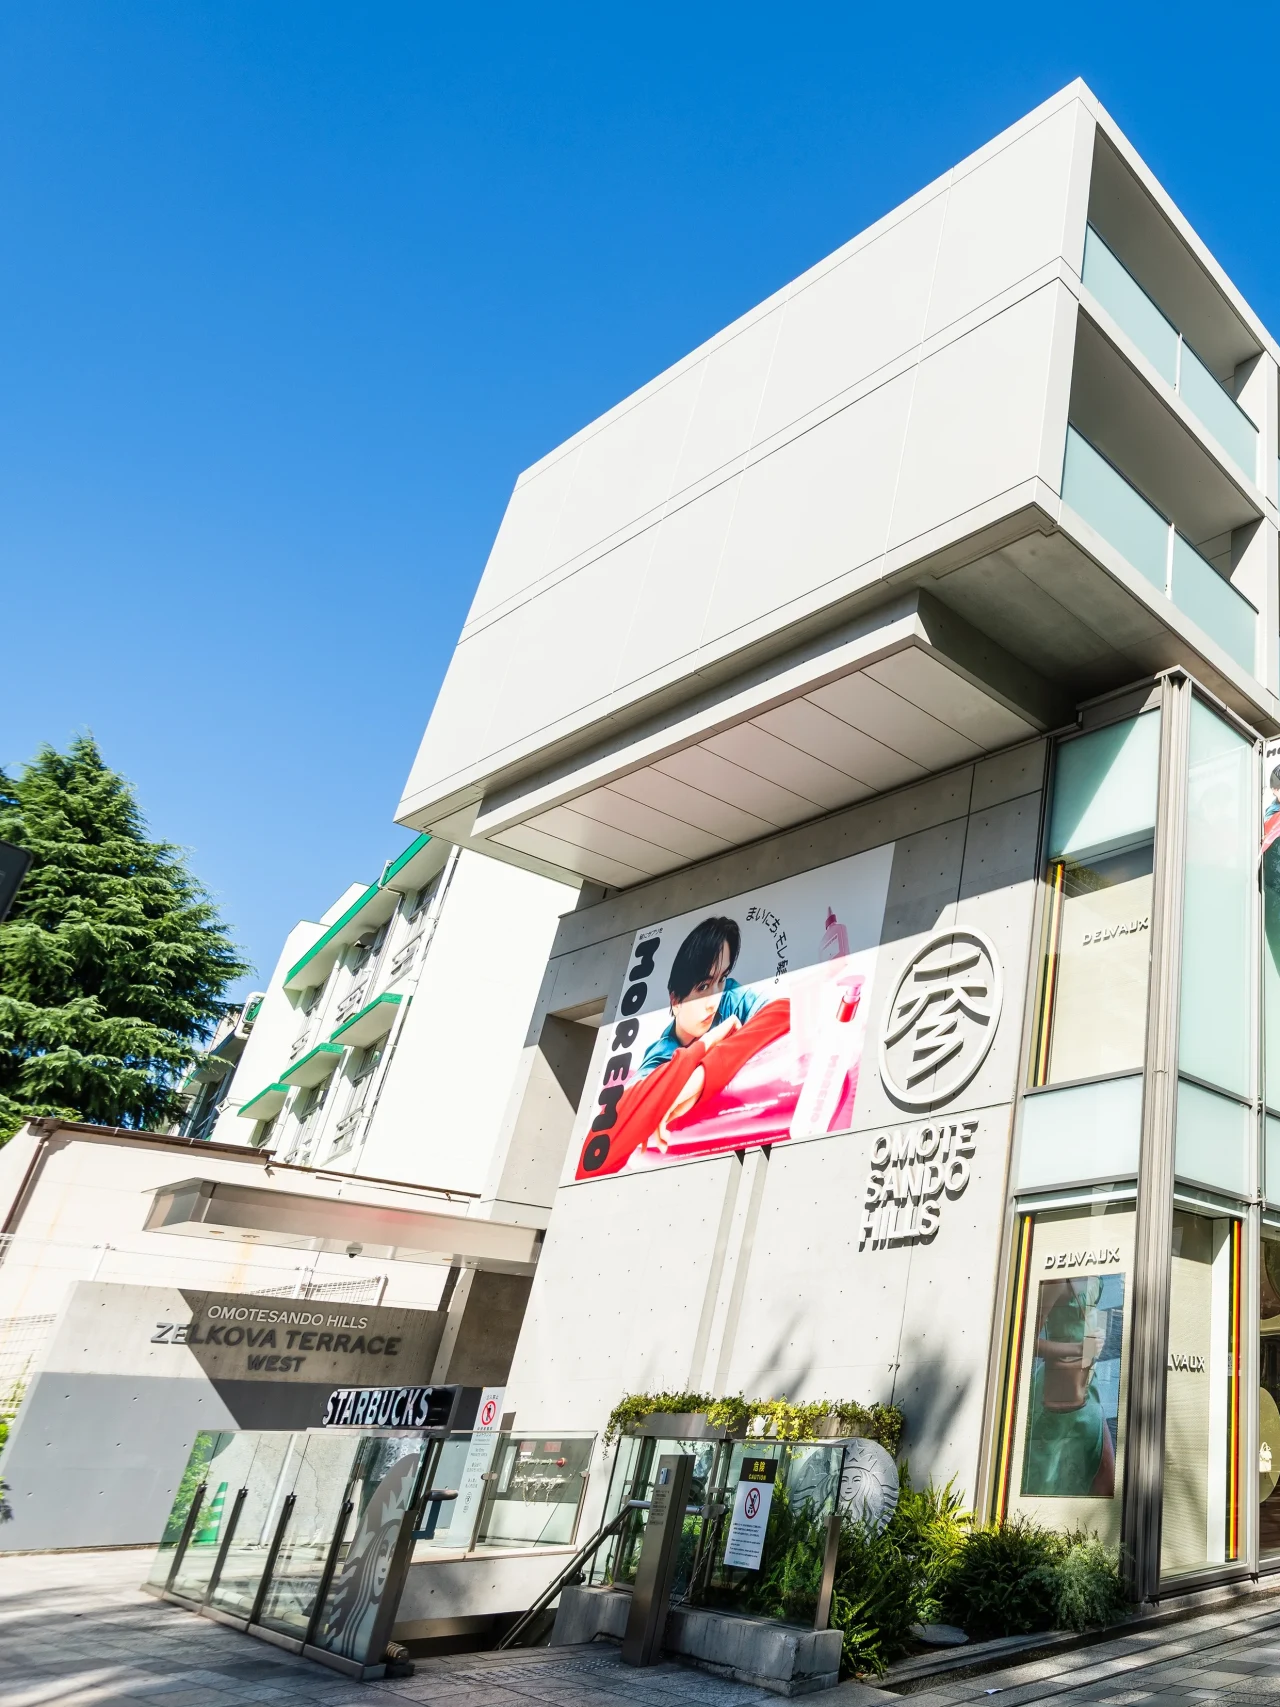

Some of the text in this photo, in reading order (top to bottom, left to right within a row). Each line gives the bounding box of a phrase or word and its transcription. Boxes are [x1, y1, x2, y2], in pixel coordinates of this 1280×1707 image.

[1082, 917, 1148, 946] DELVAUX
[583, 936, 661, 1171] MOREMO
[870, 1116, 979, 1168] OMOTE
[865, 1155, 971, 1203] SANDO
[858, 1200, 941, 1247] HILLS
[1044, 1247, 1121, 1269] DELVAUX
[207, 1305, 368, 1329] OMOTESANDO HILLS
[150, 1322, 402, 1356] ZELKOVA TERRACE
[247, 1354, 306, 1373] WEST
[322, 1387, 433, 1427] STARBUCKS
[748, 1473, 767, 1481] CAUTION
[752, 1460, 766, 1473] 危険
